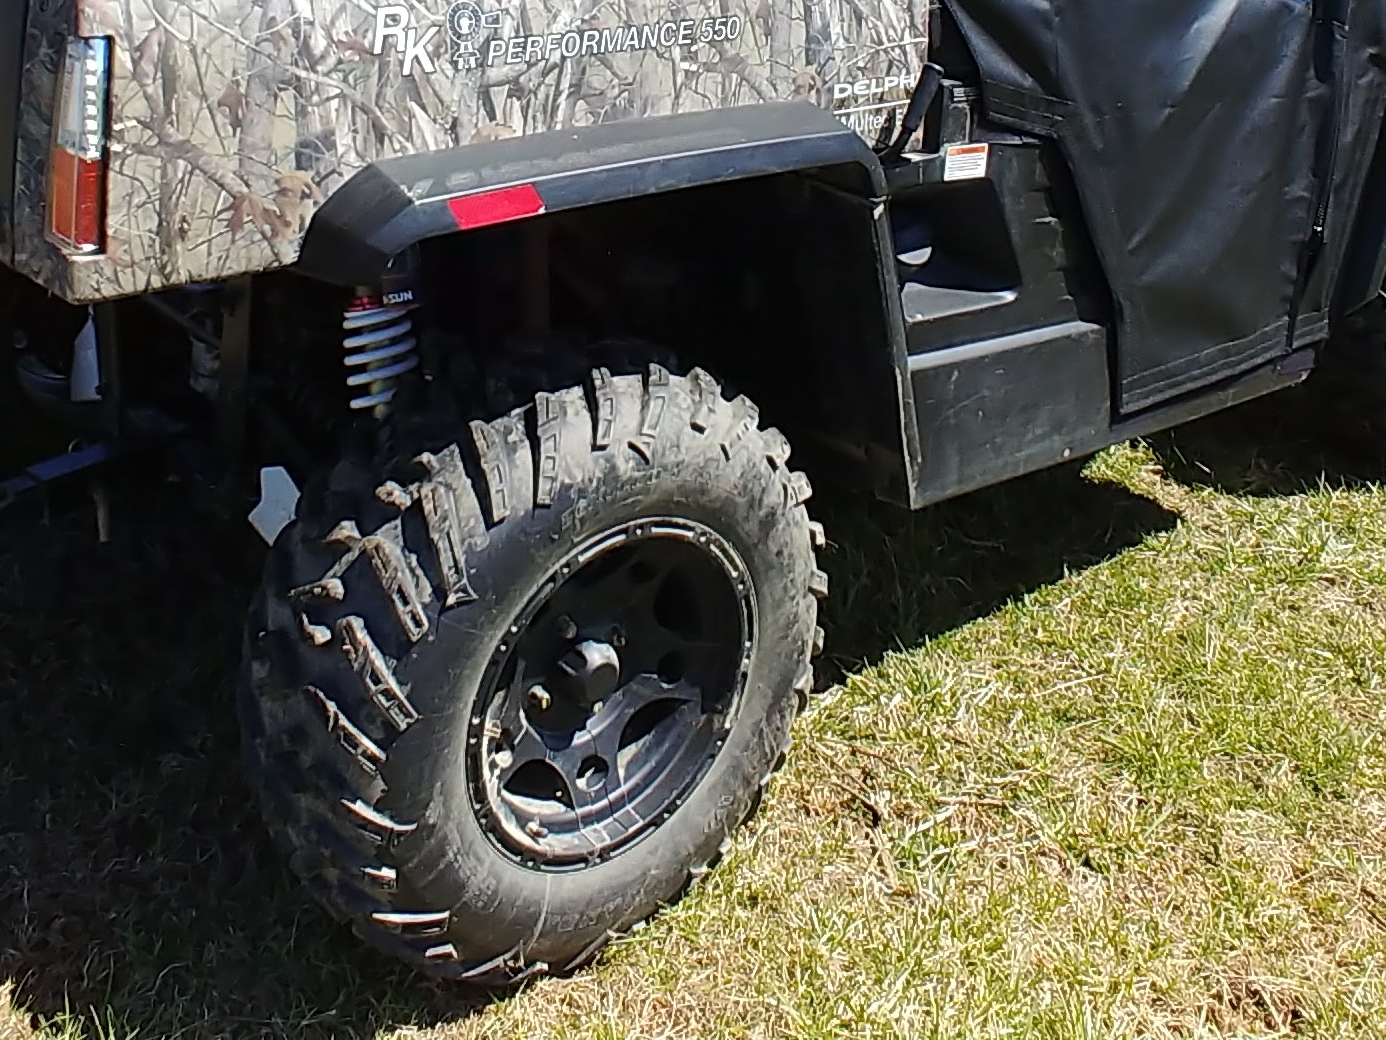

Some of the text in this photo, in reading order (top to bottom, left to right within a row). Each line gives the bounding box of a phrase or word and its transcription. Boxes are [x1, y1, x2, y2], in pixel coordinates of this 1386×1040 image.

[373, 4, 441, 76] RK
[487, 15, 741, 66] PERFORMANCE 550
